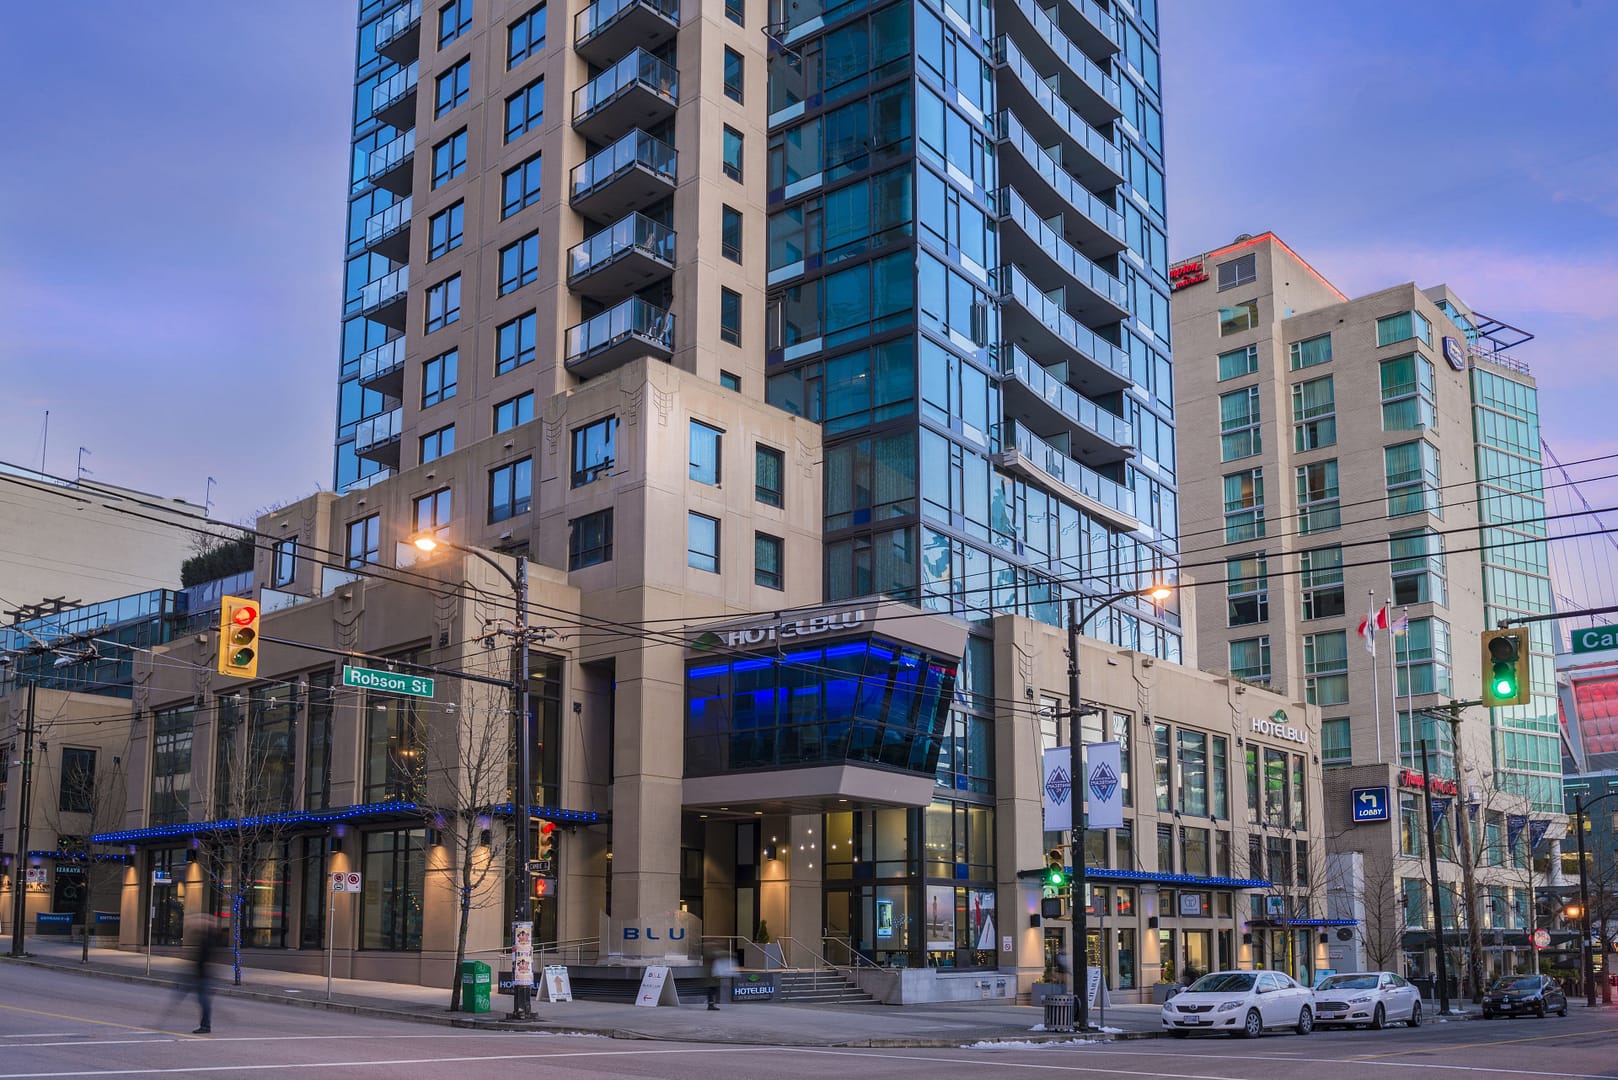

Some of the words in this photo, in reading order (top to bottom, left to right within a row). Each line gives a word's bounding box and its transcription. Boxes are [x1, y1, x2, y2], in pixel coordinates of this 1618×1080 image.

[727, 609, 864, 647] HOTELBLU
[1582, 631, 1618, 648] Ca
[350, 669, 405, 690] Robson
[411, 679, 427, 693] St
[1252, 717, 1308, 743] HOTELBLU
[1359, 808, 1383, 816] LOBBY
[623, 927, 685, 941] BLU
[734, 986, 775, 996] HOTELBLU
